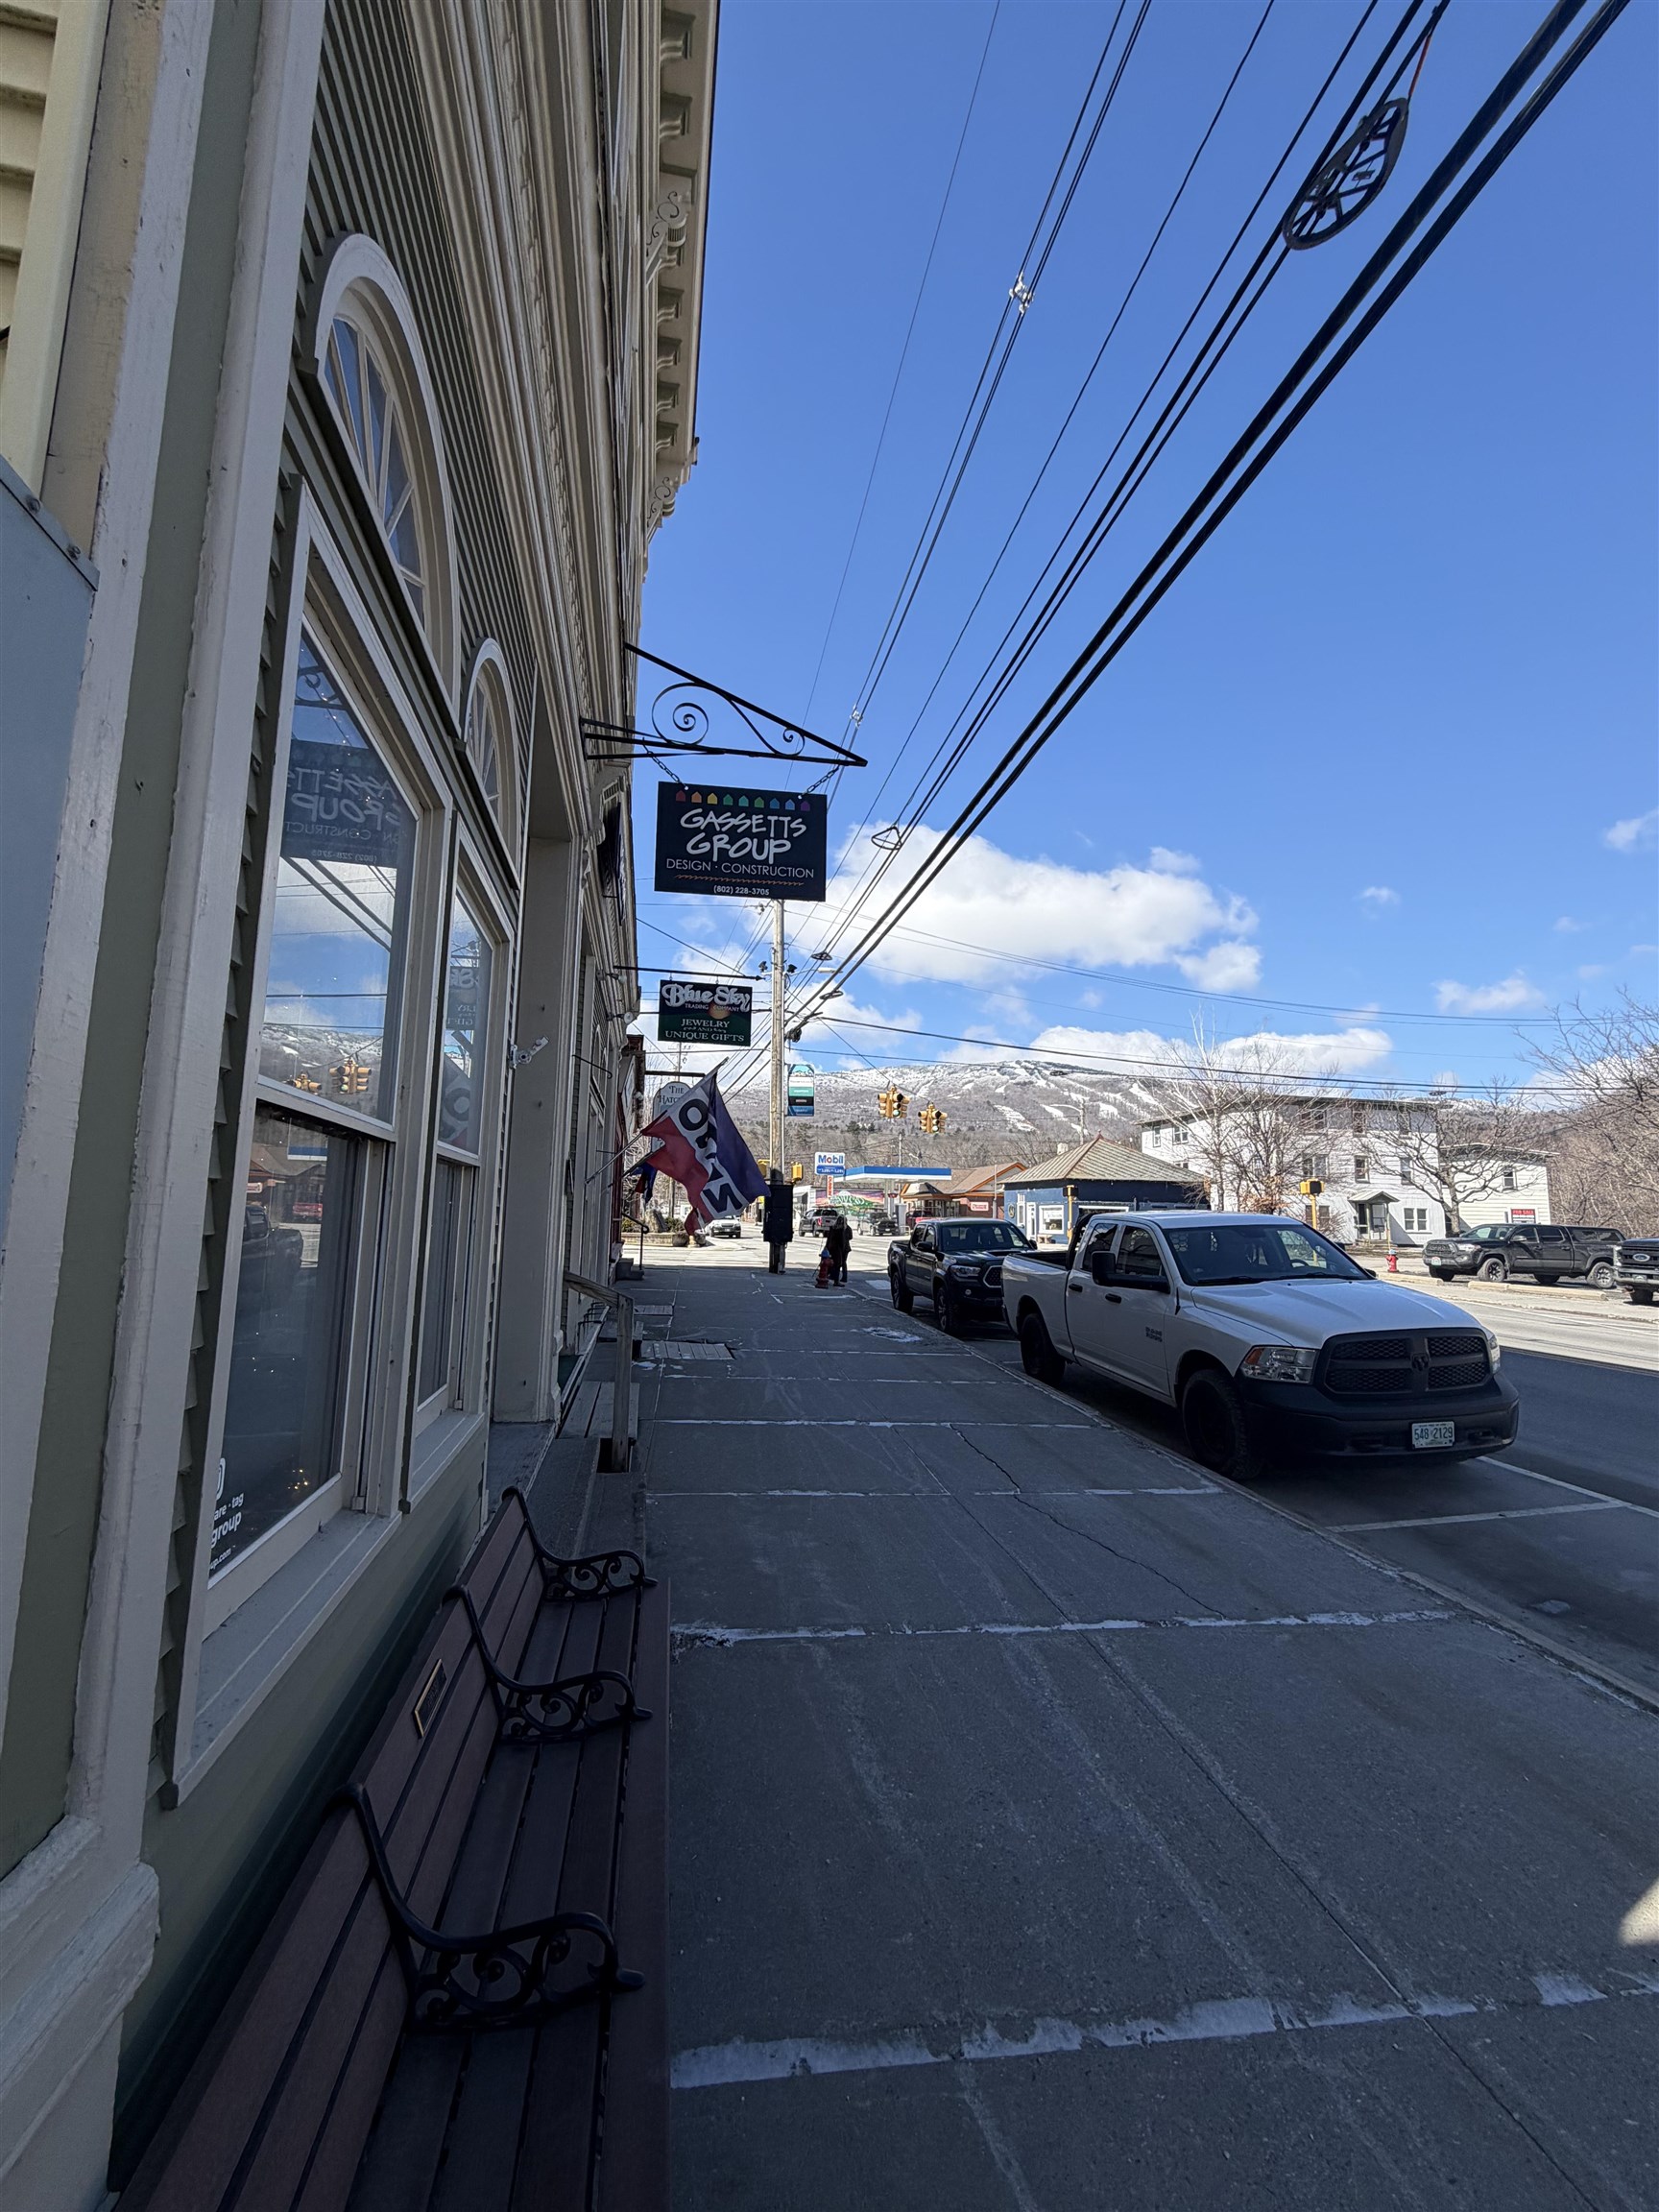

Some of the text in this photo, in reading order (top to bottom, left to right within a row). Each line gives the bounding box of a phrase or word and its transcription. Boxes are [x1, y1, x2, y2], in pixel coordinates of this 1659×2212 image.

[680, 807, 807, 839] GASSETTS
[685, 831, 792, 864] GROUP
[666, 858, 814, 878] DESIGN CONSTRUCTION
[713, 884, 770, 896] (802) 228-3705
[661, 983, 751, 1012] Blue Sky
[681, 1019, 730, 1028] JEWELRY
[665, 1030, 745, 1042] UNIQUE GIFTS
[669, 1086, 685, 1094] THE
[658, 1095, 680, 1105] HATC
[818, 1154, 844, 1165] Mobil
[1414, 1427, 1454, 1440] 548 2129
[213, 1492, 244, 1521] are tag
[211, 1511, 241, 1548] group
